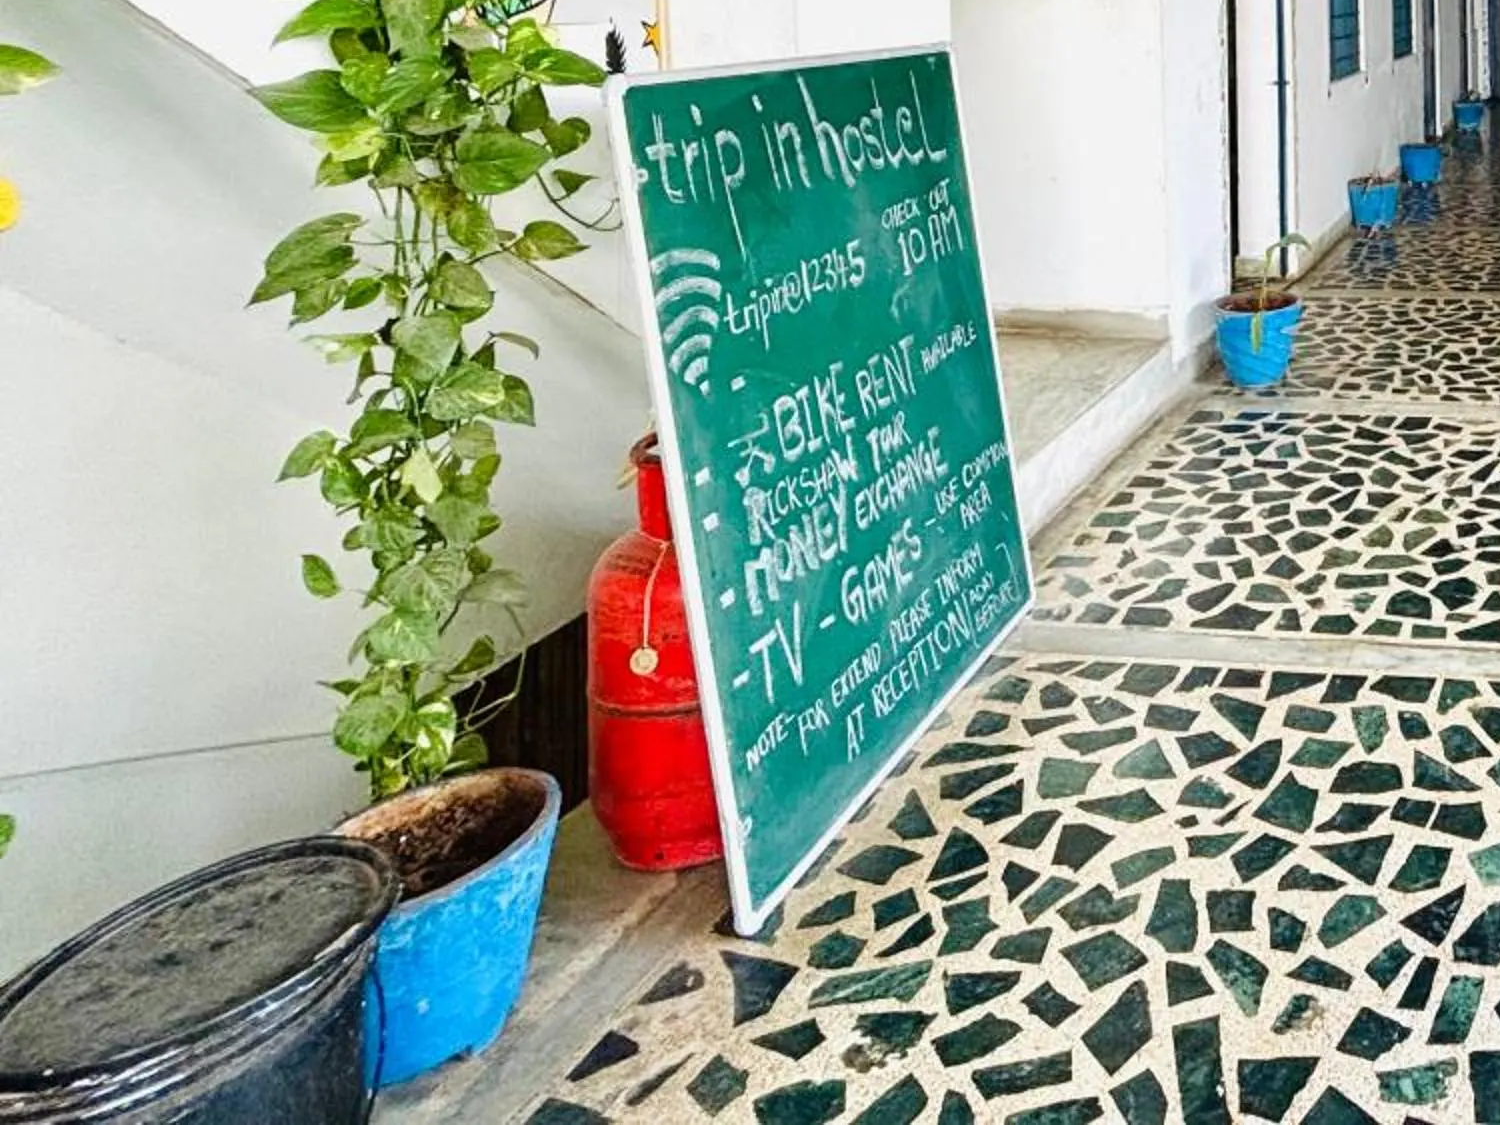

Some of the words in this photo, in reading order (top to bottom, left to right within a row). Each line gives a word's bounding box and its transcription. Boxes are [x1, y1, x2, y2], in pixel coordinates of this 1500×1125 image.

[645, 104, 746, 263] trip
[752, 94, 812, 190] in
[881, 197, 921, 229] CHECK
[928, 177, 951, 211] OUT
[896, 227, 927, 276] 10
[927, 204, 964, 262] AM
[723, 238, 866, 354] tripin@12345
[773, 360, 856, 462] BIKE
[857, 334, 918, 417] RENT
[921, 322, 977, 373] AVAILABLE
[743, 435, 859, 545] RICKSHAW
[866, 411, 912, 474] TOUR
[745, 484, 848, 615] MONEY
[854, 426, 950, 531] EXCHANGE
[959, 480, 993, 530] AREA
[749, 601, 805, 705] TV
[841, 518, 924, 624] GAMES
[934, 476, 961, 516] USE
[796, 701, 832, 756] FOR
[831, 643, 882, 710] EXTEND
[890, 591, 935, 654] PLEASE
[935, 542, 986, 606] INFORM
[845, 702, 866, 763] AT
